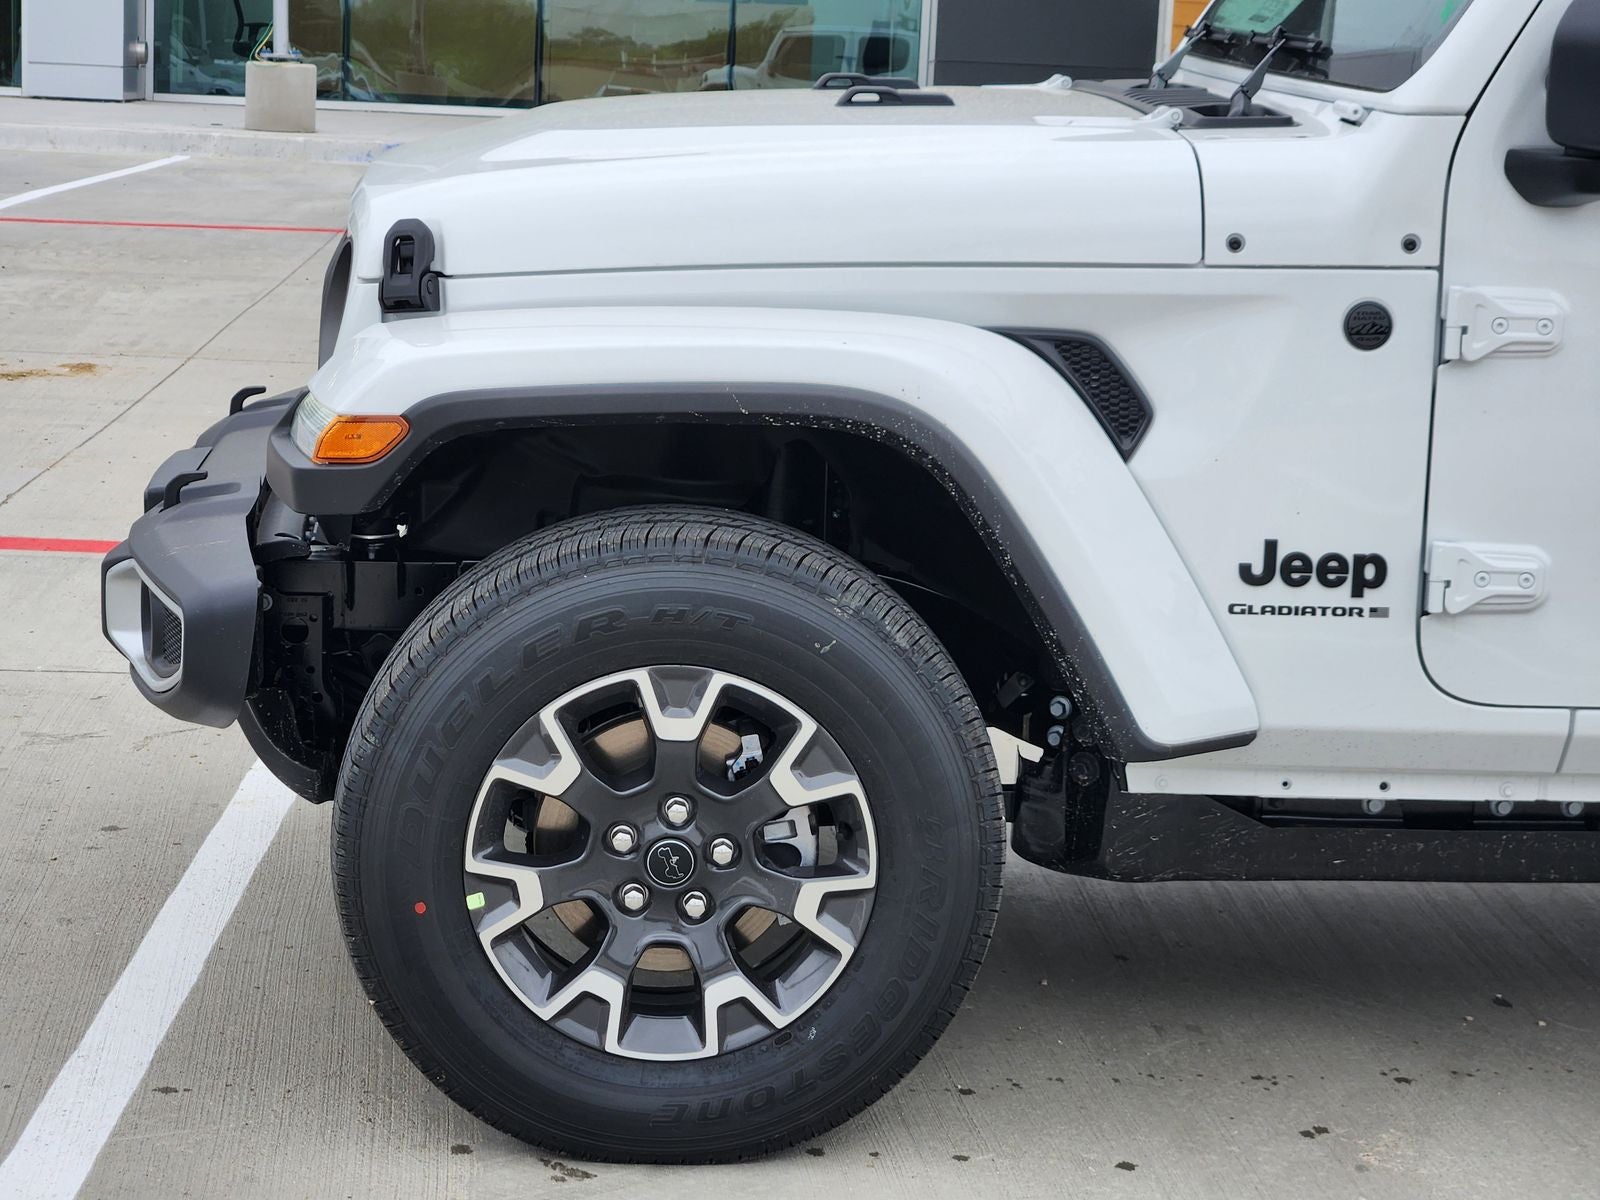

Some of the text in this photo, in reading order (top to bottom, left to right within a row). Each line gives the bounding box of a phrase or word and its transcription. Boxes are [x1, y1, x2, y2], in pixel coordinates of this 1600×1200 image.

[1227, 603, 1365, 618] GLADIATOR
[1238, 538, 1388, 598] Jeep
[398, 603, 754, 867] DUELER H/T
[650, 813, 949, 1128] BRIDGESTONE
